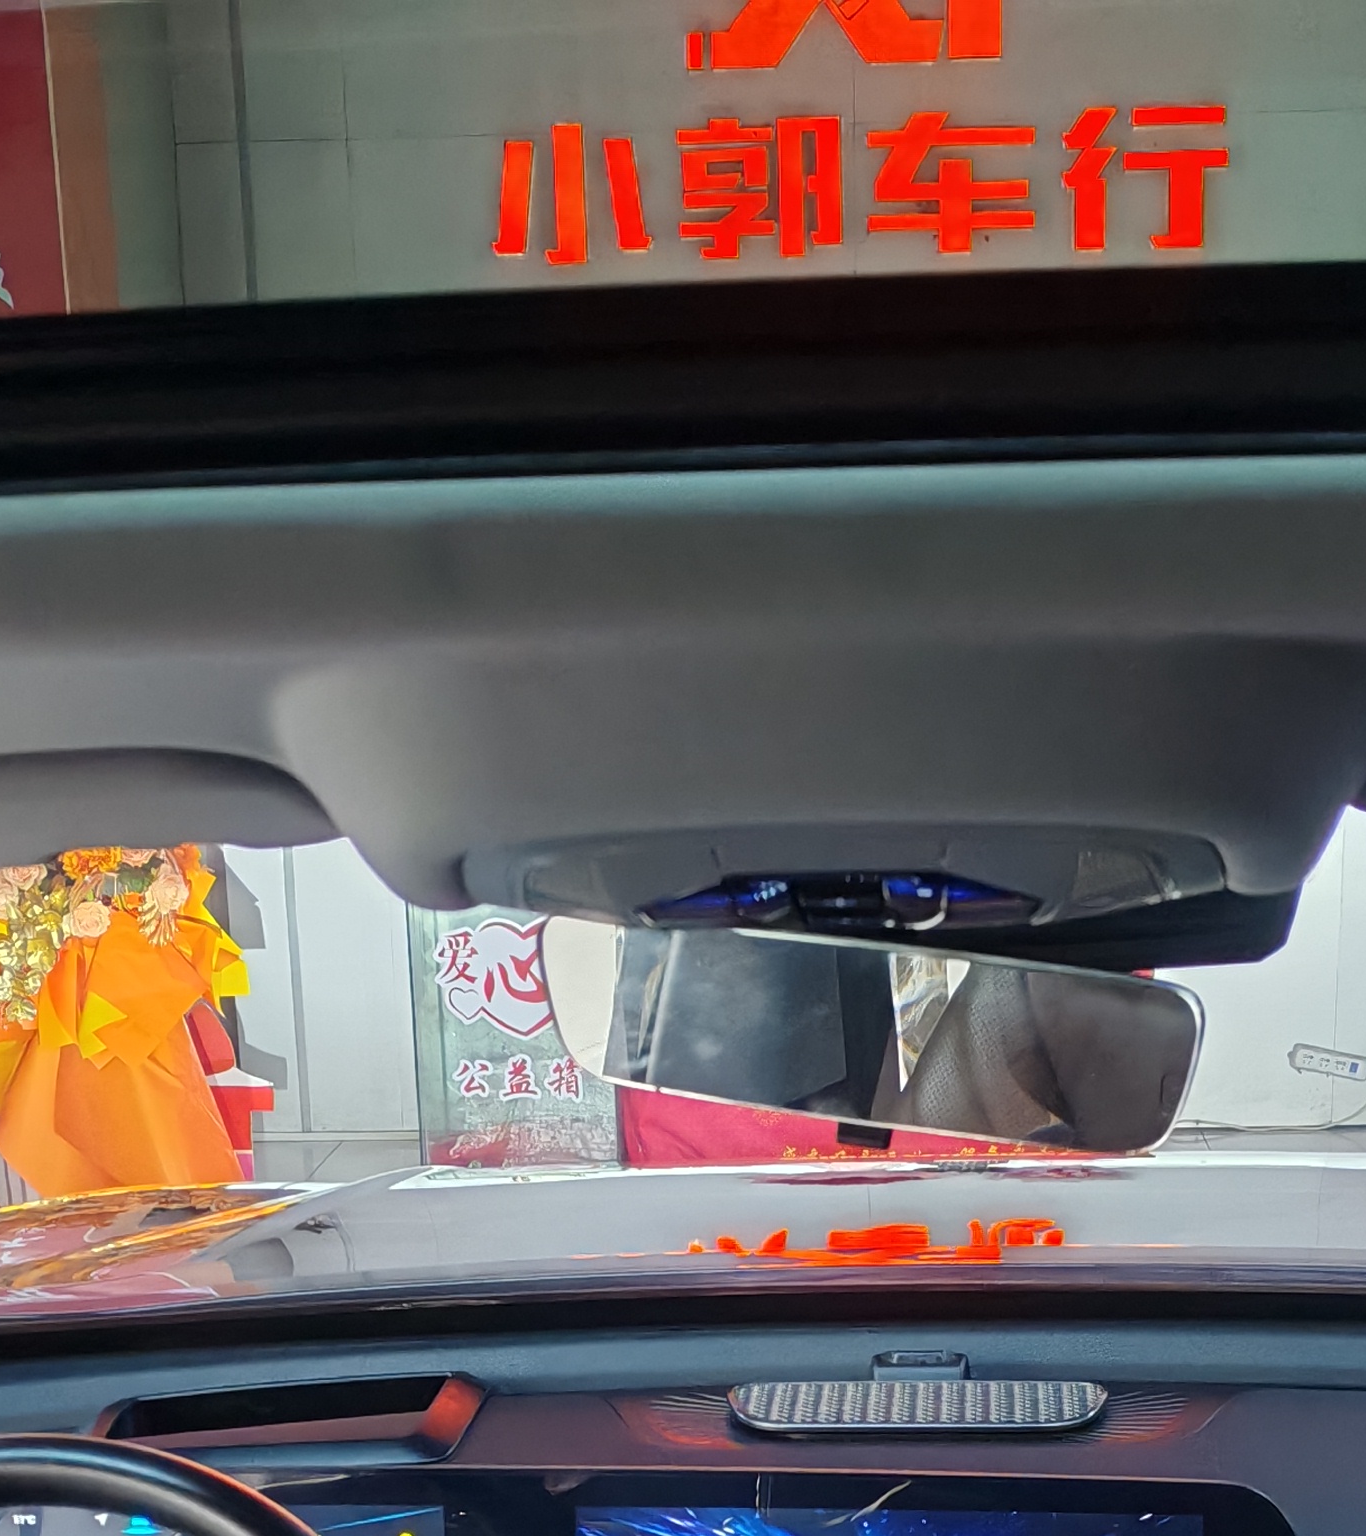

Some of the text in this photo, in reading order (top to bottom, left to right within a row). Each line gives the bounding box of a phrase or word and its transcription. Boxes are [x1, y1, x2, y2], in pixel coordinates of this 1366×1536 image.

[492, 106, 1230, 264] 小郭车行
[438, 930, 550, 1004] 爱心
[456, 1058, 581, 1099] 公益箱
